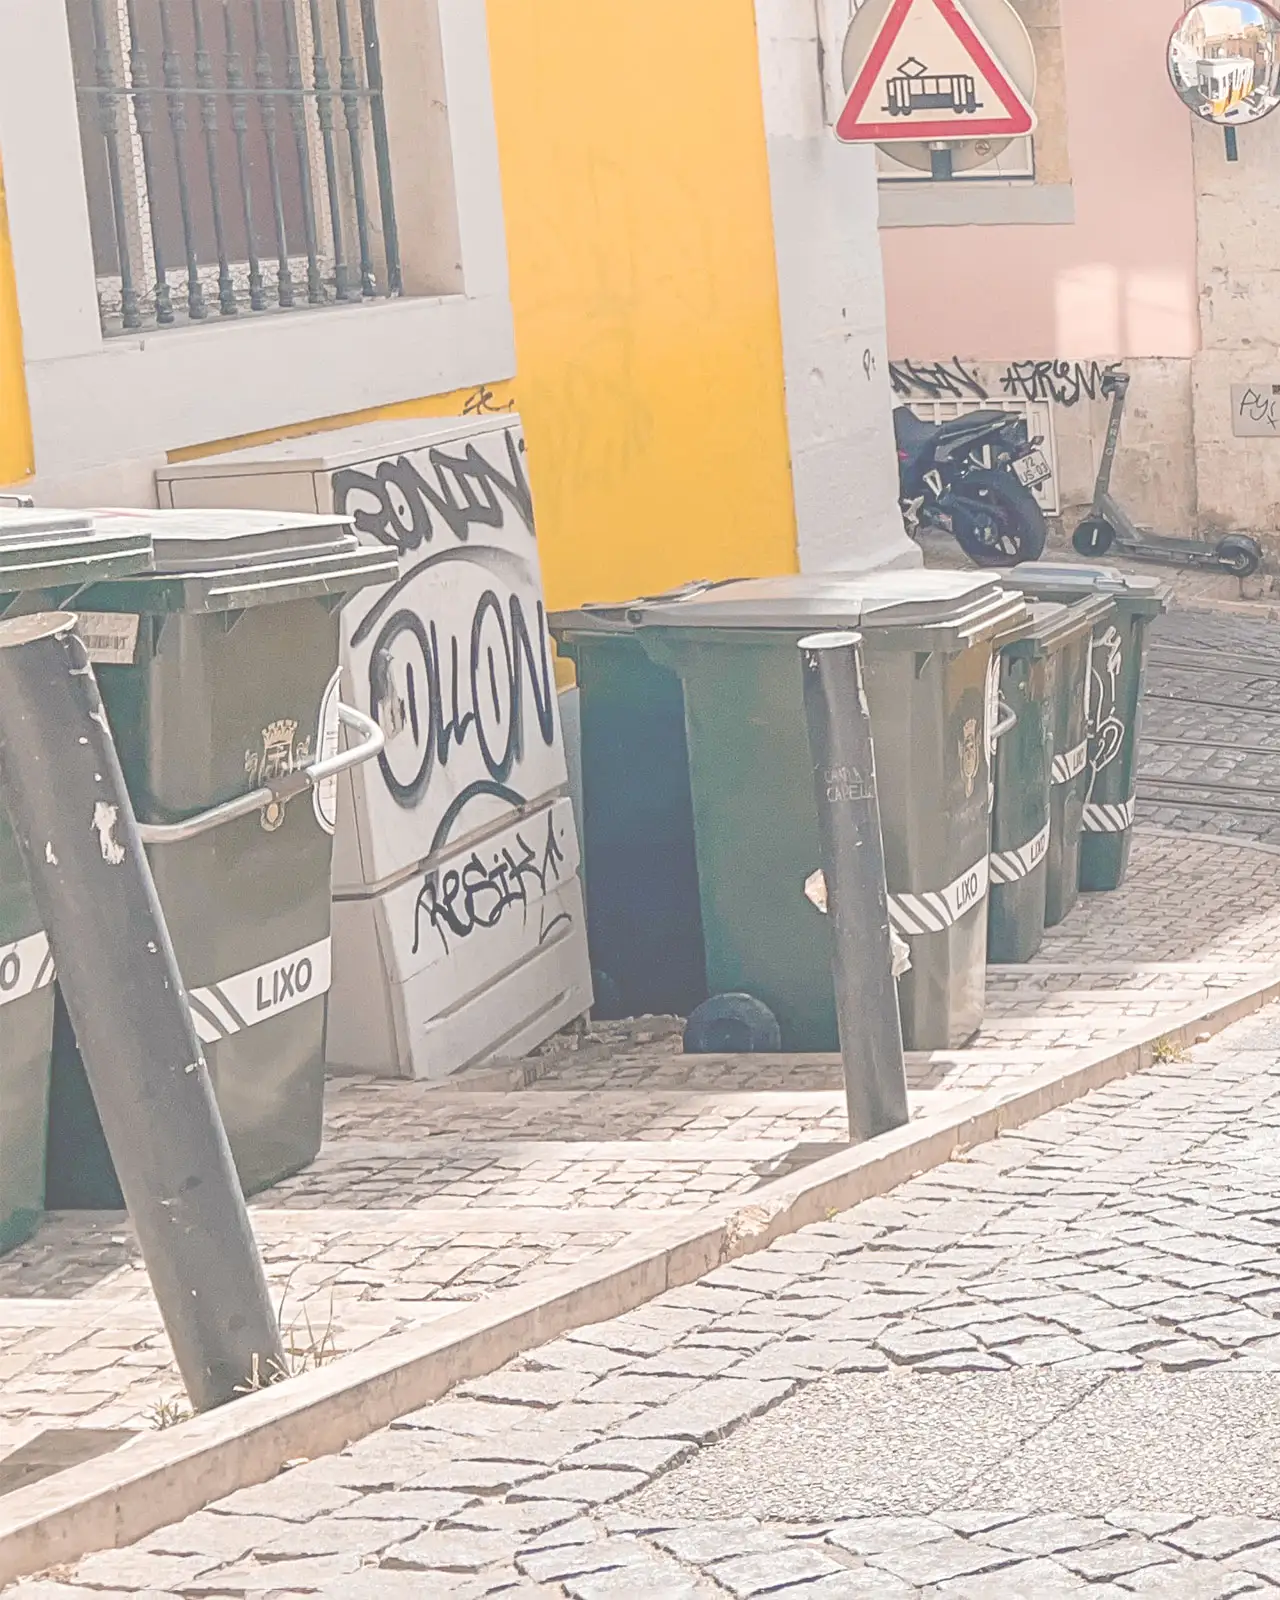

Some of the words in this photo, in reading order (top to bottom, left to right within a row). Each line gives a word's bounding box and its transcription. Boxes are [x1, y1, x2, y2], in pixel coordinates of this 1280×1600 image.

[1022, 456, 1037, 469] 72
[955, 872, 978, 911] LIXO
[256, 956, 313, 1012] LIXO
